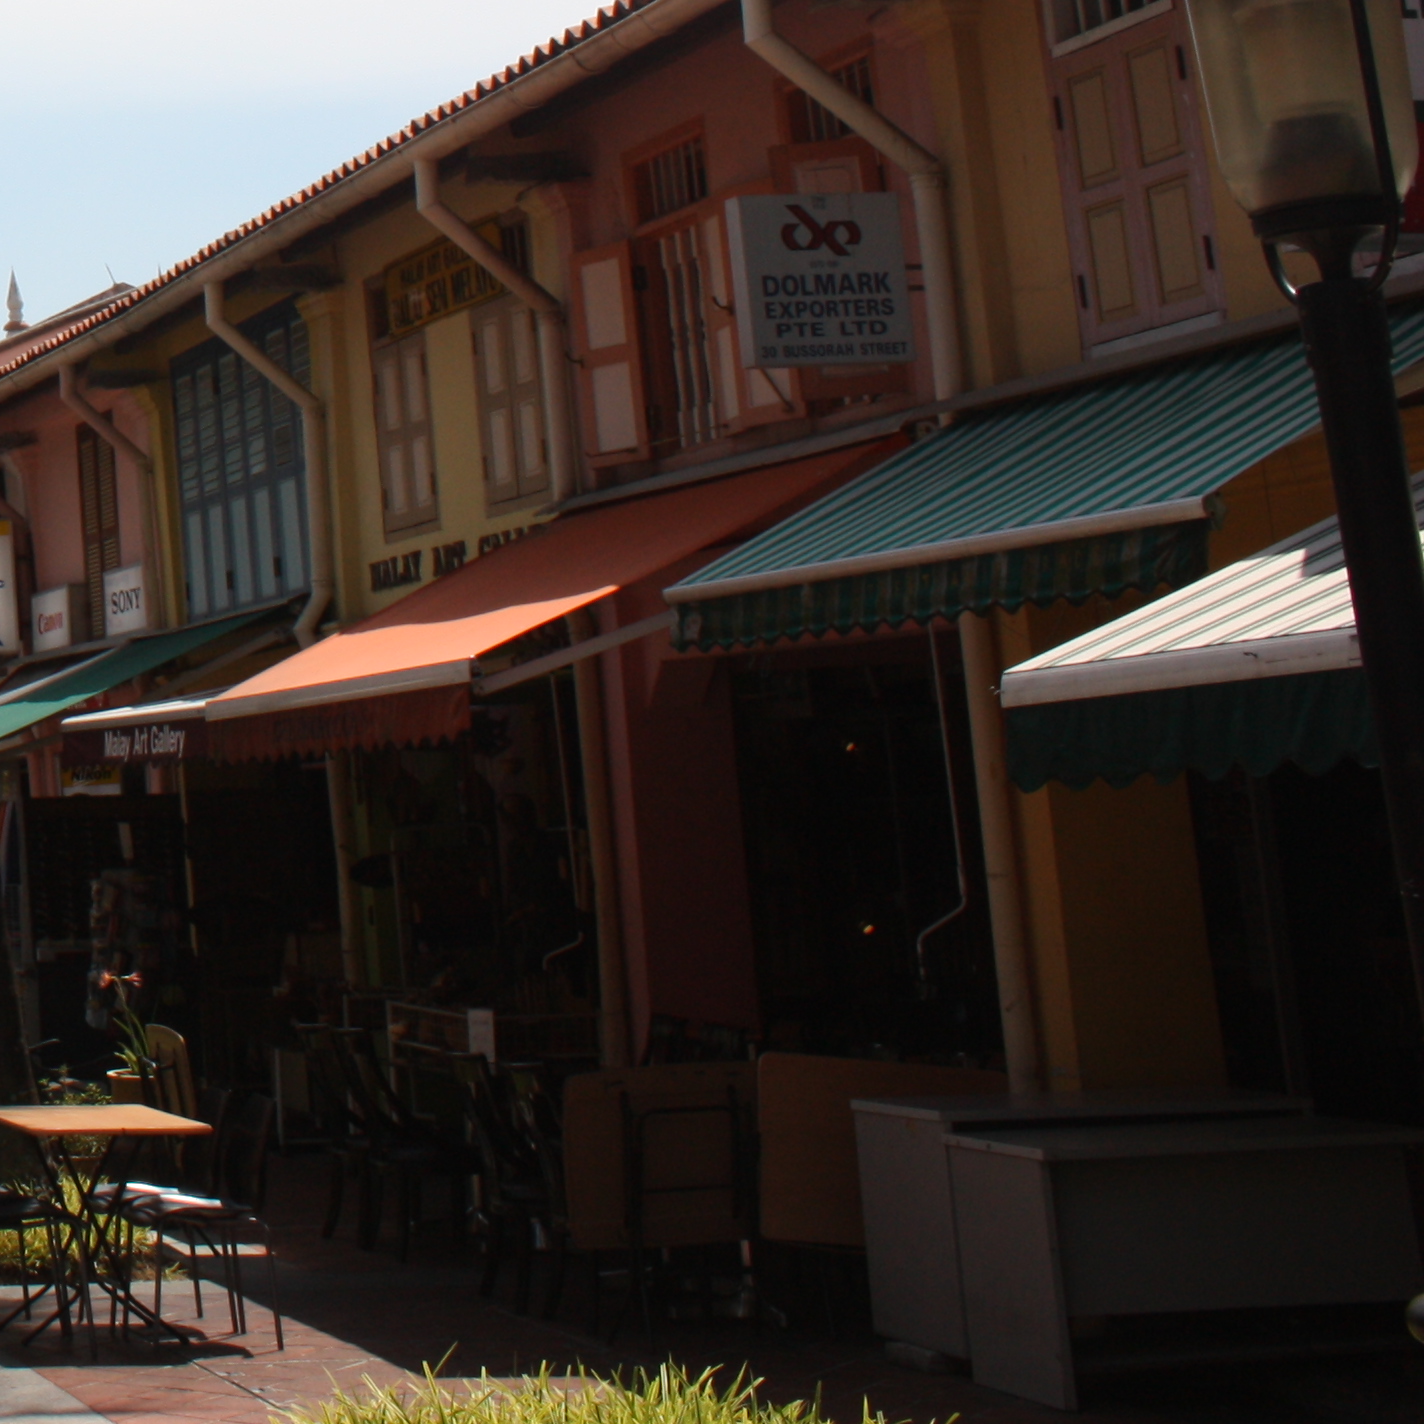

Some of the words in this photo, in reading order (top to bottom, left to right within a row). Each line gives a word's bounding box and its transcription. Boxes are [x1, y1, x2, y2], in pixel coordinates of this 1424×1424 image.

[762, 272, 891, 297] DOLMARK
[765, 299, 894, 319] EXPORTERS
[776, 322, 825, 338] PTE
[840, 320, 888, 336] LTD
[762, 345, 777, 358] 30
[783, 344, 854, 358] BUSSORAH
[860, 342, 907, 355] STREET
[368, 550, 422, 592] MALAY
[111, 587, 141, 614] SONY
[38, 612, 63, 635] Canon
[104, 729, 130, 763] Malay
[132, 727, 148, 756] Art
[150, 724, 186, 759] Gallery
